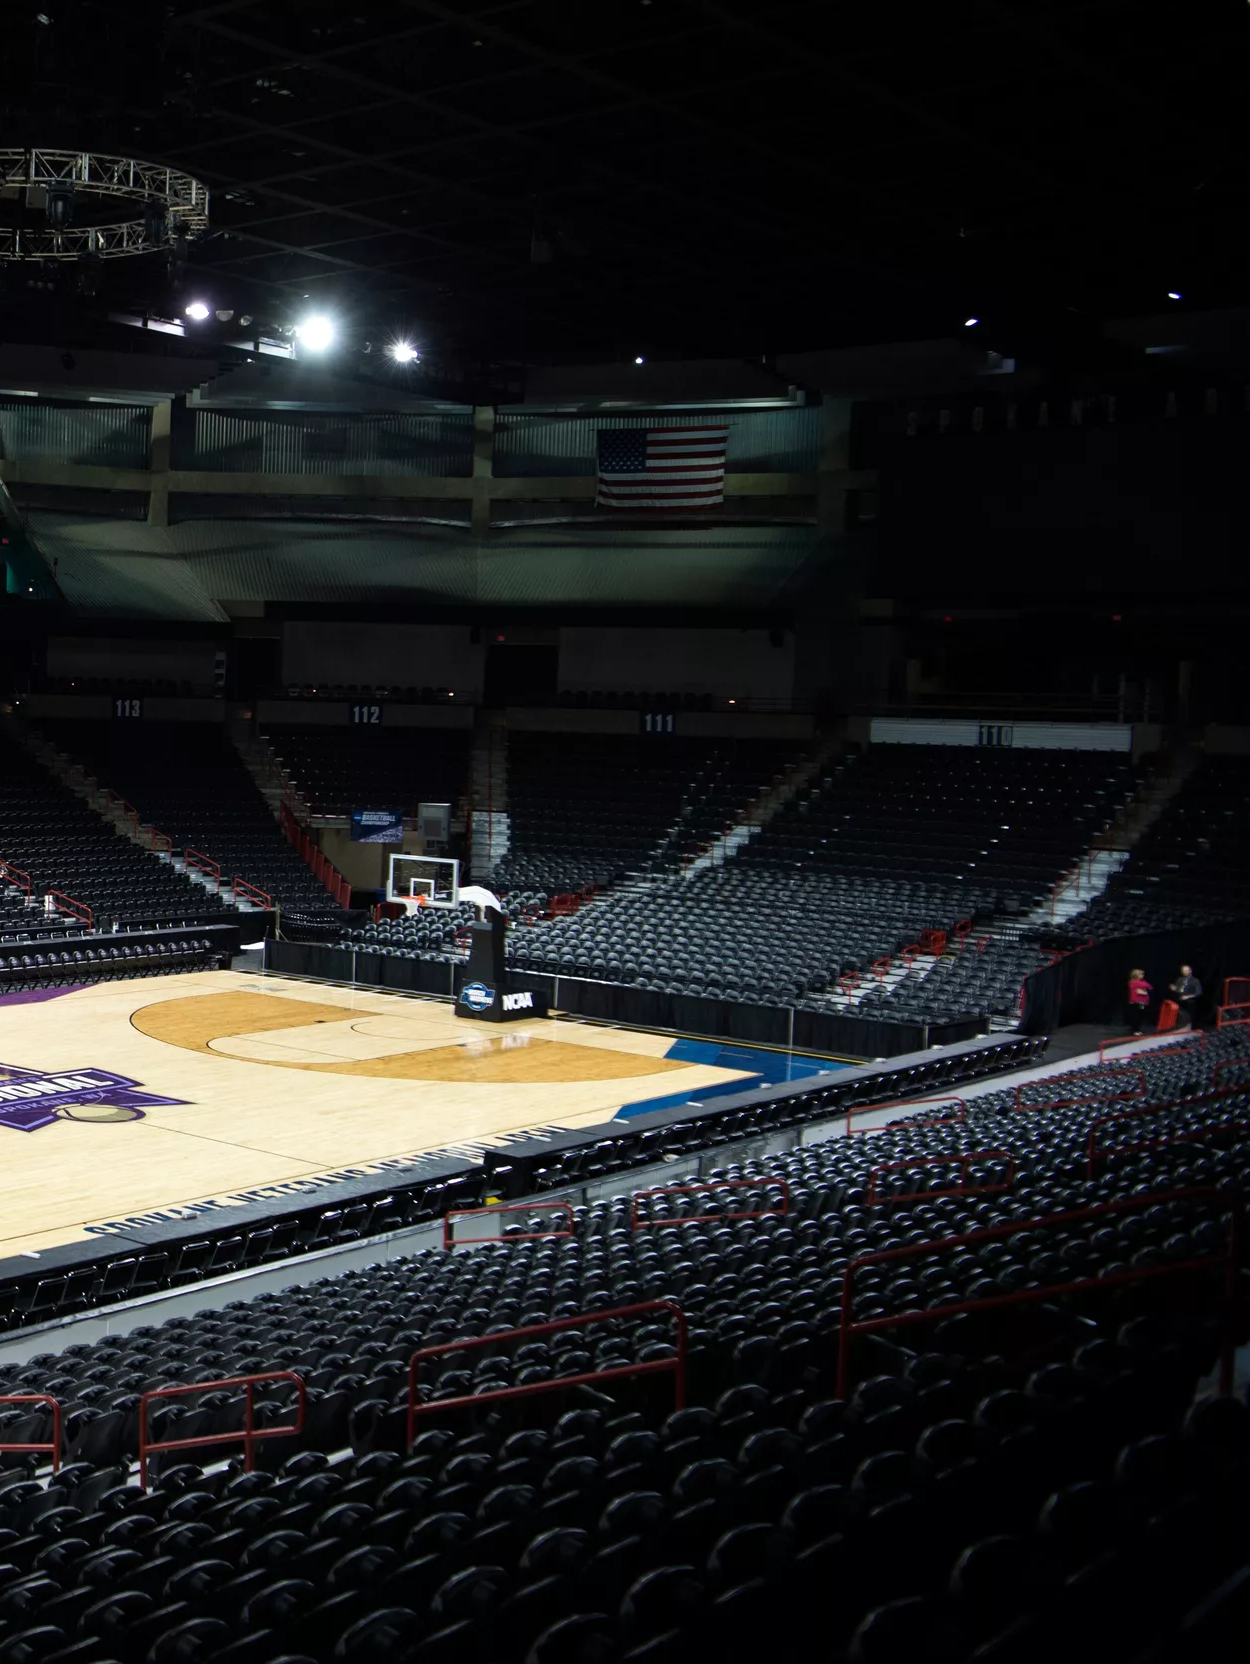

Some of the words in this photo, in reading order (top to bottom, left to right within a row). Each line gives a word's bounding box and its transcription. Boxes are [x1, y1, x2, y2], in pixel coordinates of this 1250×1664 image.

[116, 699, 141, 717] 113
[353, 706, 380, 723] 112
[645, 713, 673, 732] 111
[502, 992, 534, 1011] NCAA
